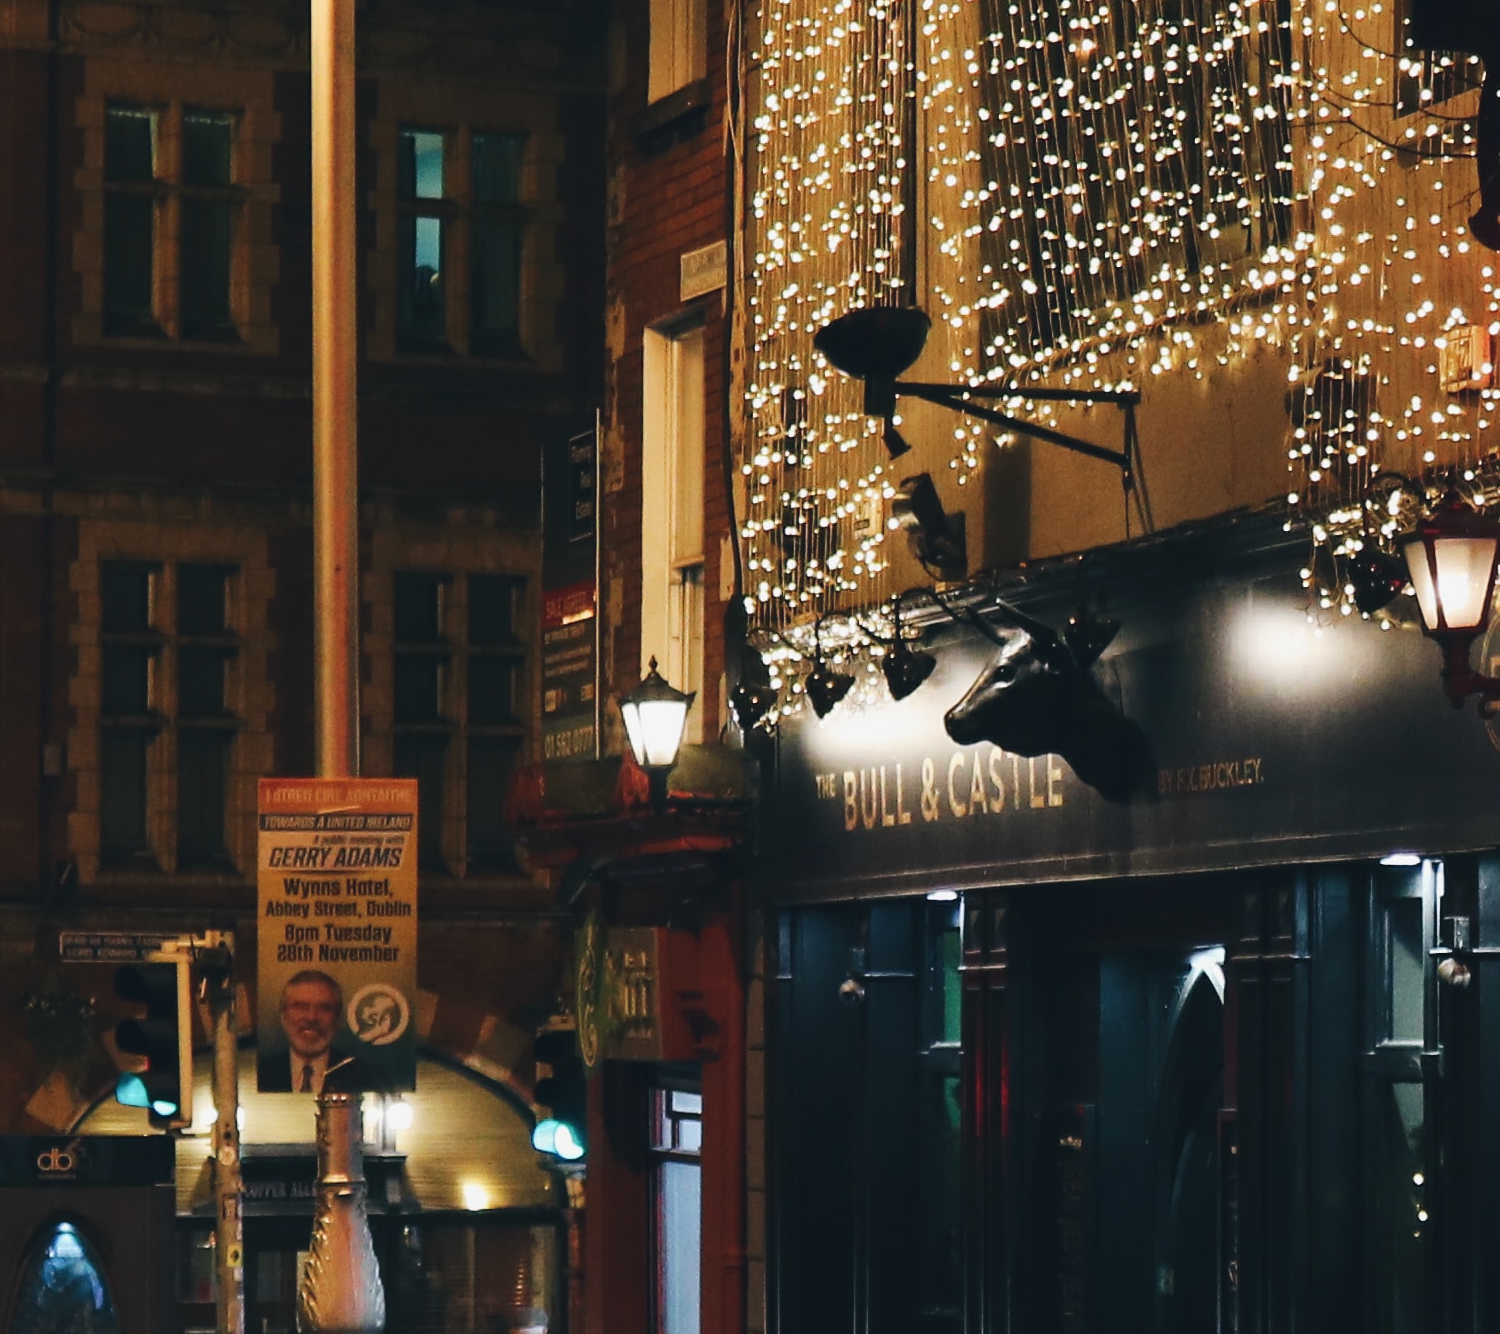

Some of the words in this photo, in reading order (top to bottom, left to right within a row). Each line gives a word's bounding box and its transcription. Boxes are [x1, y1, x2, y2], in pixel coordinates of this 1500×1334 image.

[816, 773, 836, 800] THE
[843, 763, 912, 832] BULL
[921, 757, 939, 822] &
[948, 746, 1064, 818] CASTLE
[269, 847, 331, 867] GERRY
[335, 847, 402, 867] ADAMS
[284, 878, 340, 898] Wynns
[347, 878, 393, 898] Hotel,
[266, 901, 309, 917] Abbey
[315, 901, 362, 918] Street,
[367, 900, 411, 916] Dublin
[285, 924, 319, 943] 8pm
[324, 923, 391, 944] Tuesday
[277, 943, 313, 962] 28th
[319, 943, 399, 962] November
